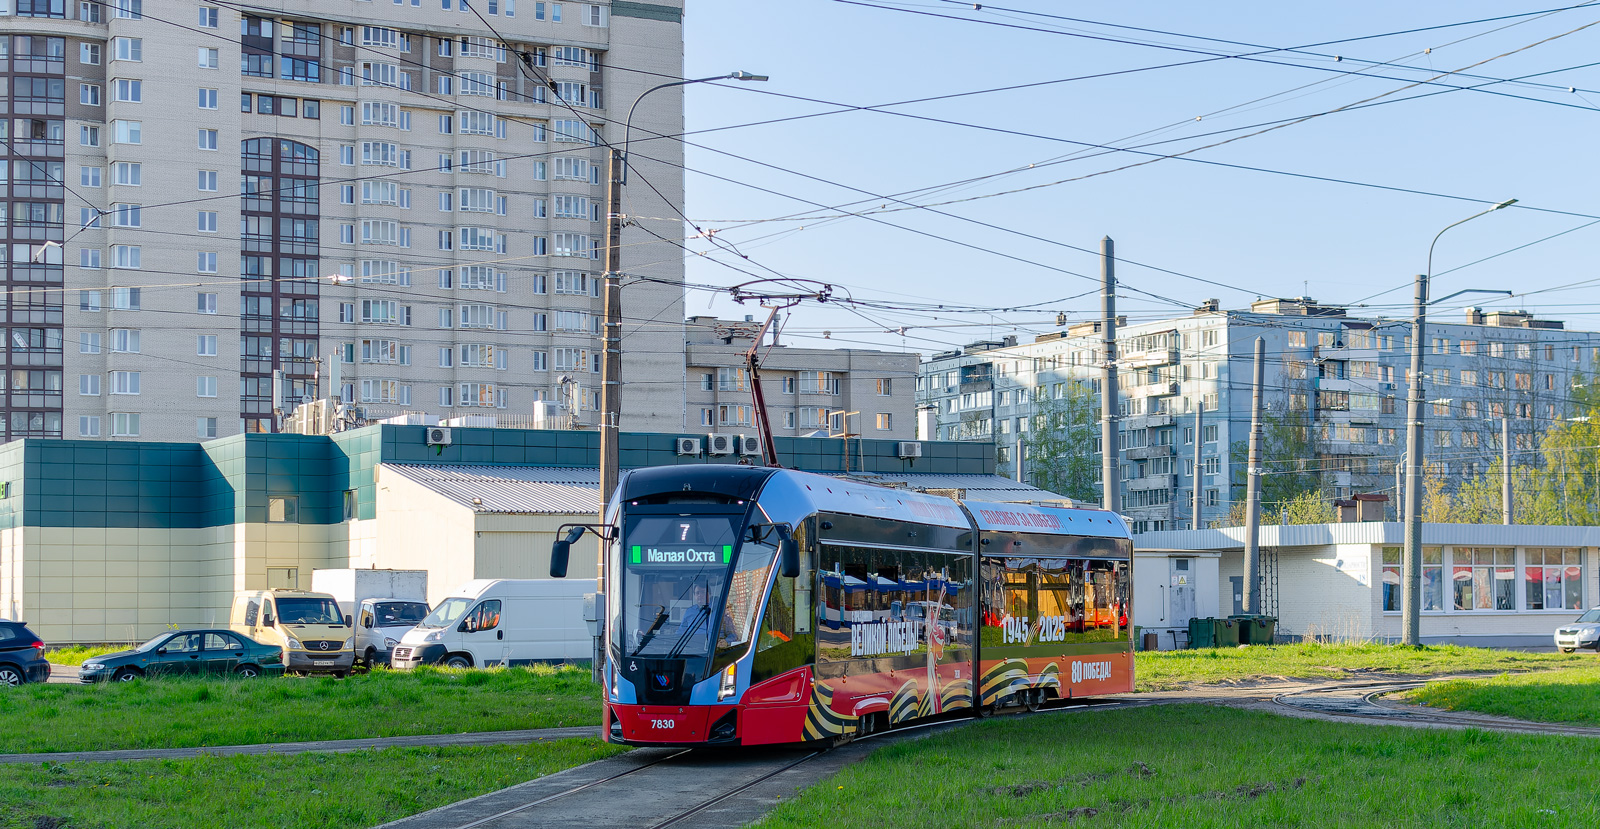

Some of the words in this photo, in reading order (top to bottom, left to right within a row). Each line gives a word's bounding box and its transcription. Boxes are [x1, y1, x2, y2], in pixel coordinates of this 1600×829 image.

[979, 509, 1021, 526] СПАСИБО
[1016, 512, 1034, 528] ЗА
[1027, 513, 1065, 531] ПОБЕДУ!
[680, 523, 691, 541] 7
[647, 548, 685, 562] Малая
[686, 548, 716, 562] Охта
[851, 617, 887, 656] ВЕЛИКОЙ
[887, 621, 919, 656] ПОБЕДЫ!
[1001, 616, 1029, 643] 1945
[1039, 615, 1066, 642] 2025
[1071, 660, 1082, 683] 80
[1083, 661, 1112, 681] ПОБЕДА!
[651, 719, 675, 729] 7830
